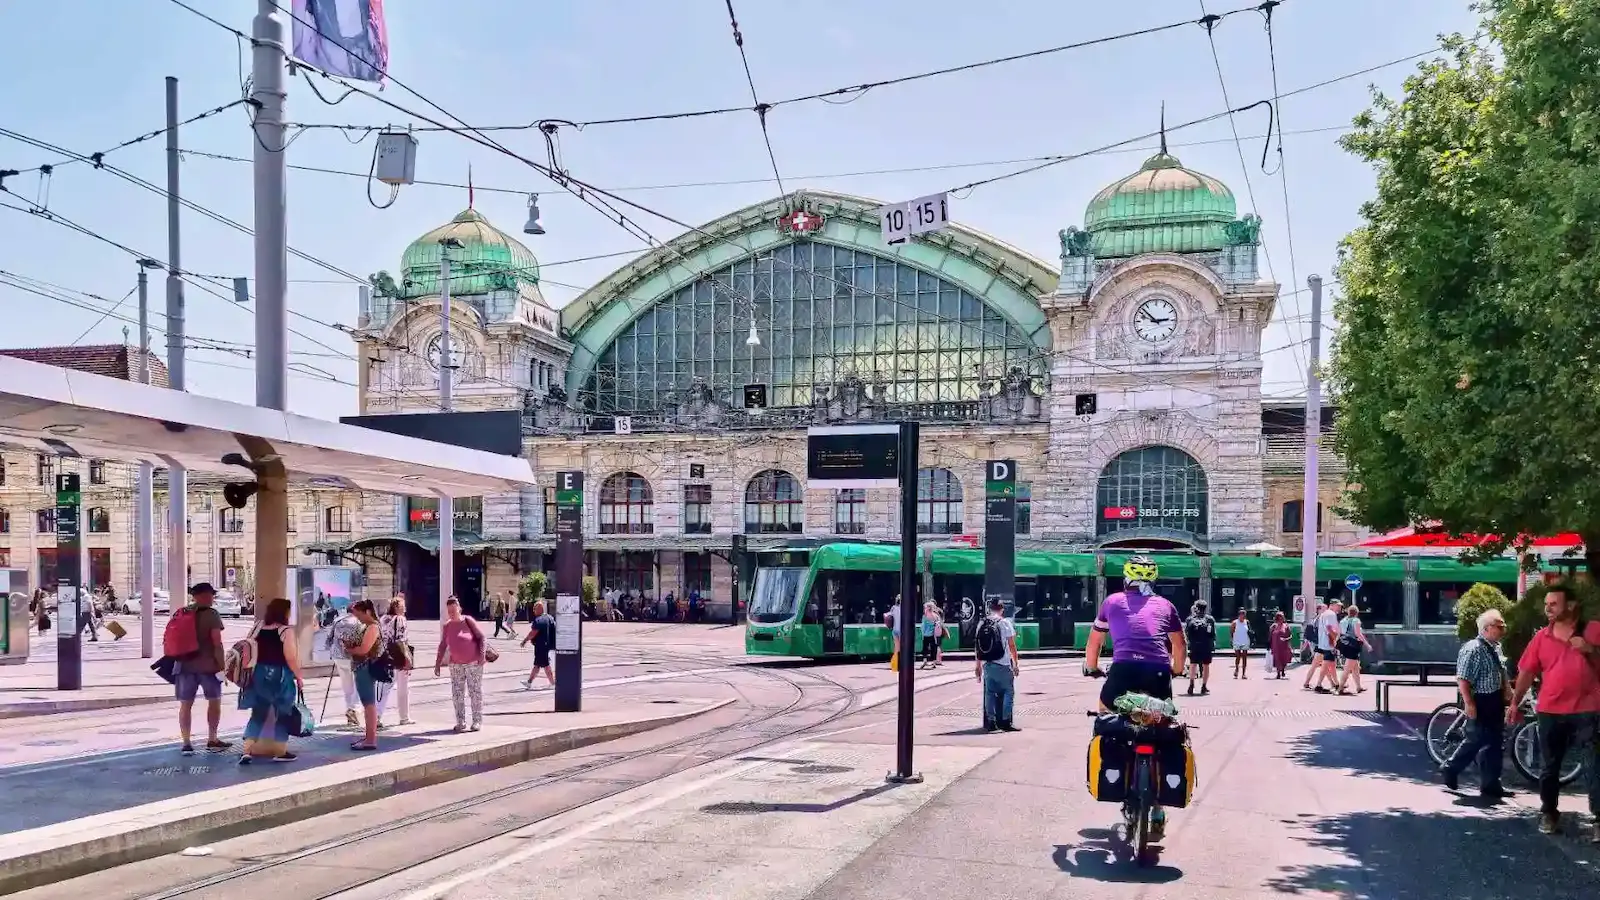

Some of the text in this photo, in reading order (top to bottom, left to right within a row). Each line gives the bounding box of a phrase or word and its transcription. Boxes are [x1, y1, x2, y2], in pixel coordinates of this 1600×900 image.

[886, 209, 904, 233] 10
[916, 202, 935, 226] 15
[618, 419, 628, 431] 15
[993, 462, 1009, 480] D
[61, 476, 70, 491] F
[564, 473, 573, 490] E
[465, 511, 480, 519] FFS
[1139, 508, 1200, 517] SBB CFF FFS
